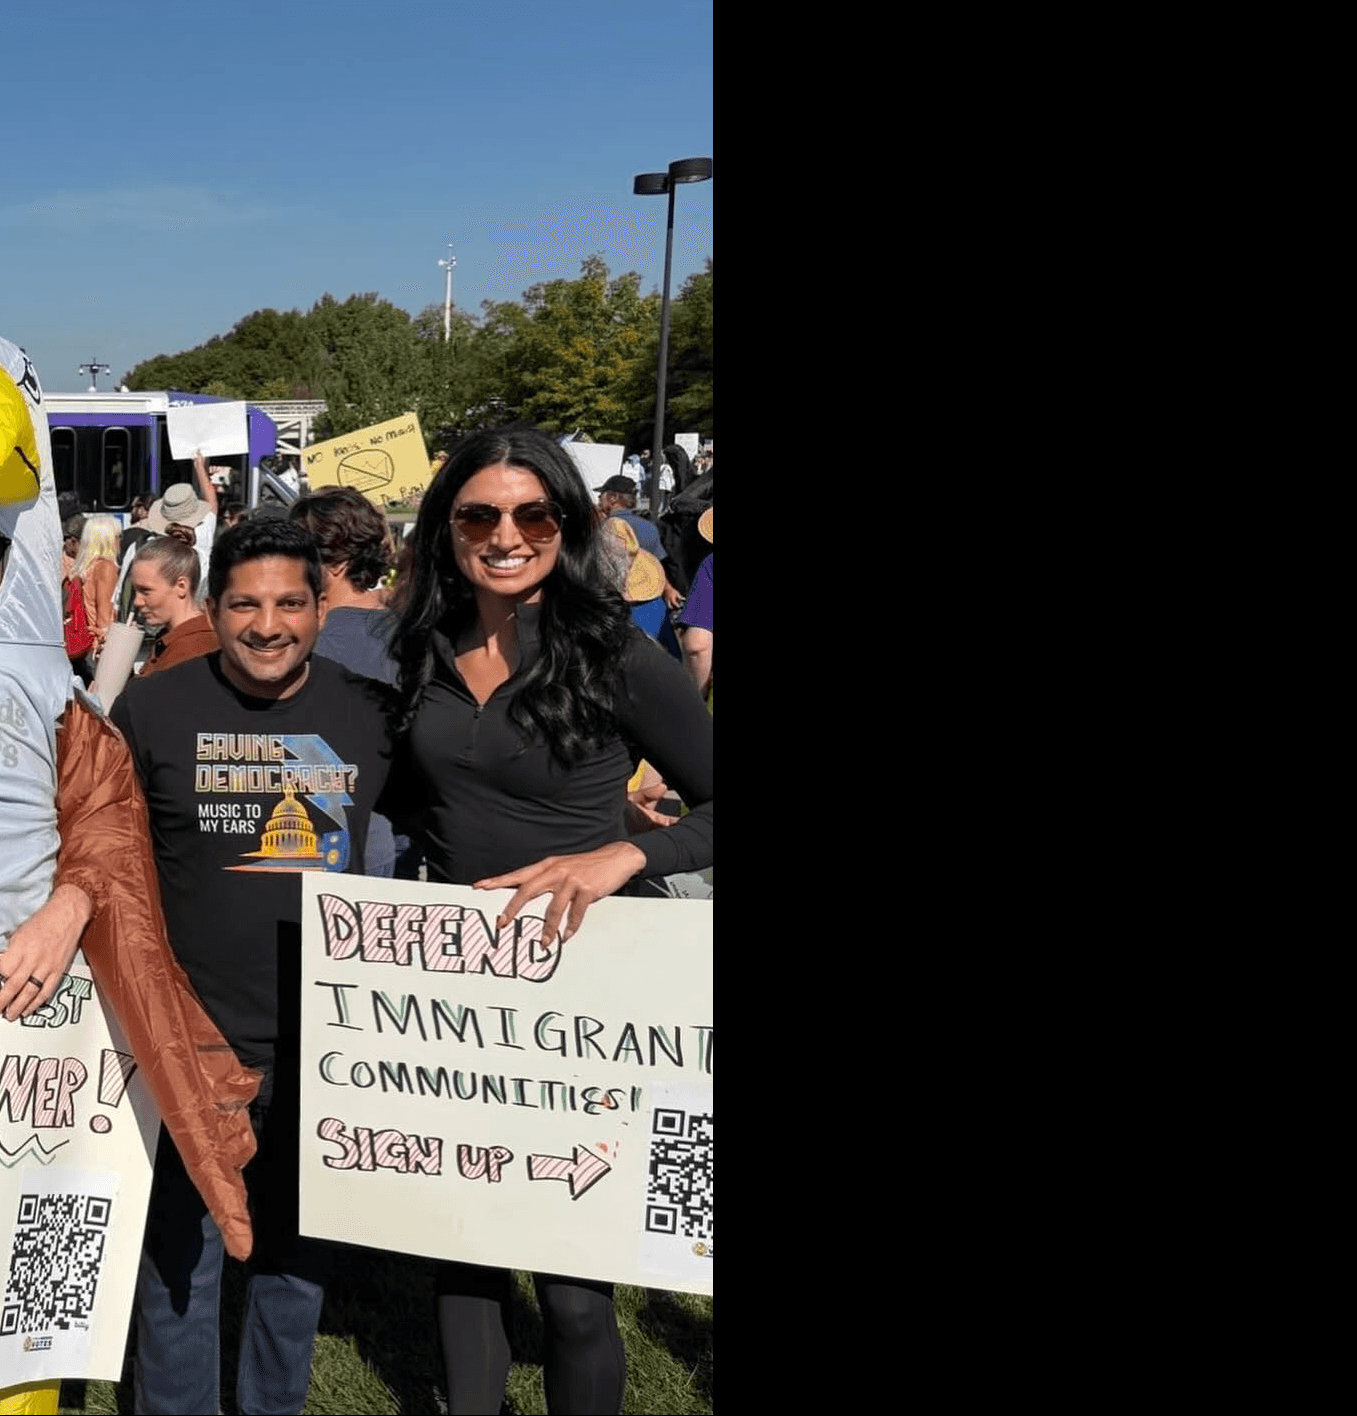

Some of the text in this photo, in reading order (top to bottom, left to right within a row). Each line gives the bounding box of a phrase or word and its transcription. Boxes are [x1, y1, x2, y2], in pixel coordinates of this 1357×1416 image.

[196, 732, 286, 762] SAVING
[195, 763, 359, 794] DEMOCRACY?
[197, 803, 262, 819] MUSIC TO
[199, 819, 257, 834] MY EARS
[316, 893, 563, 983] DEFEND
[314, 980, 713, 1075] IMMIGRANT
[316, 1116, 516, 1184] SIGN UP
